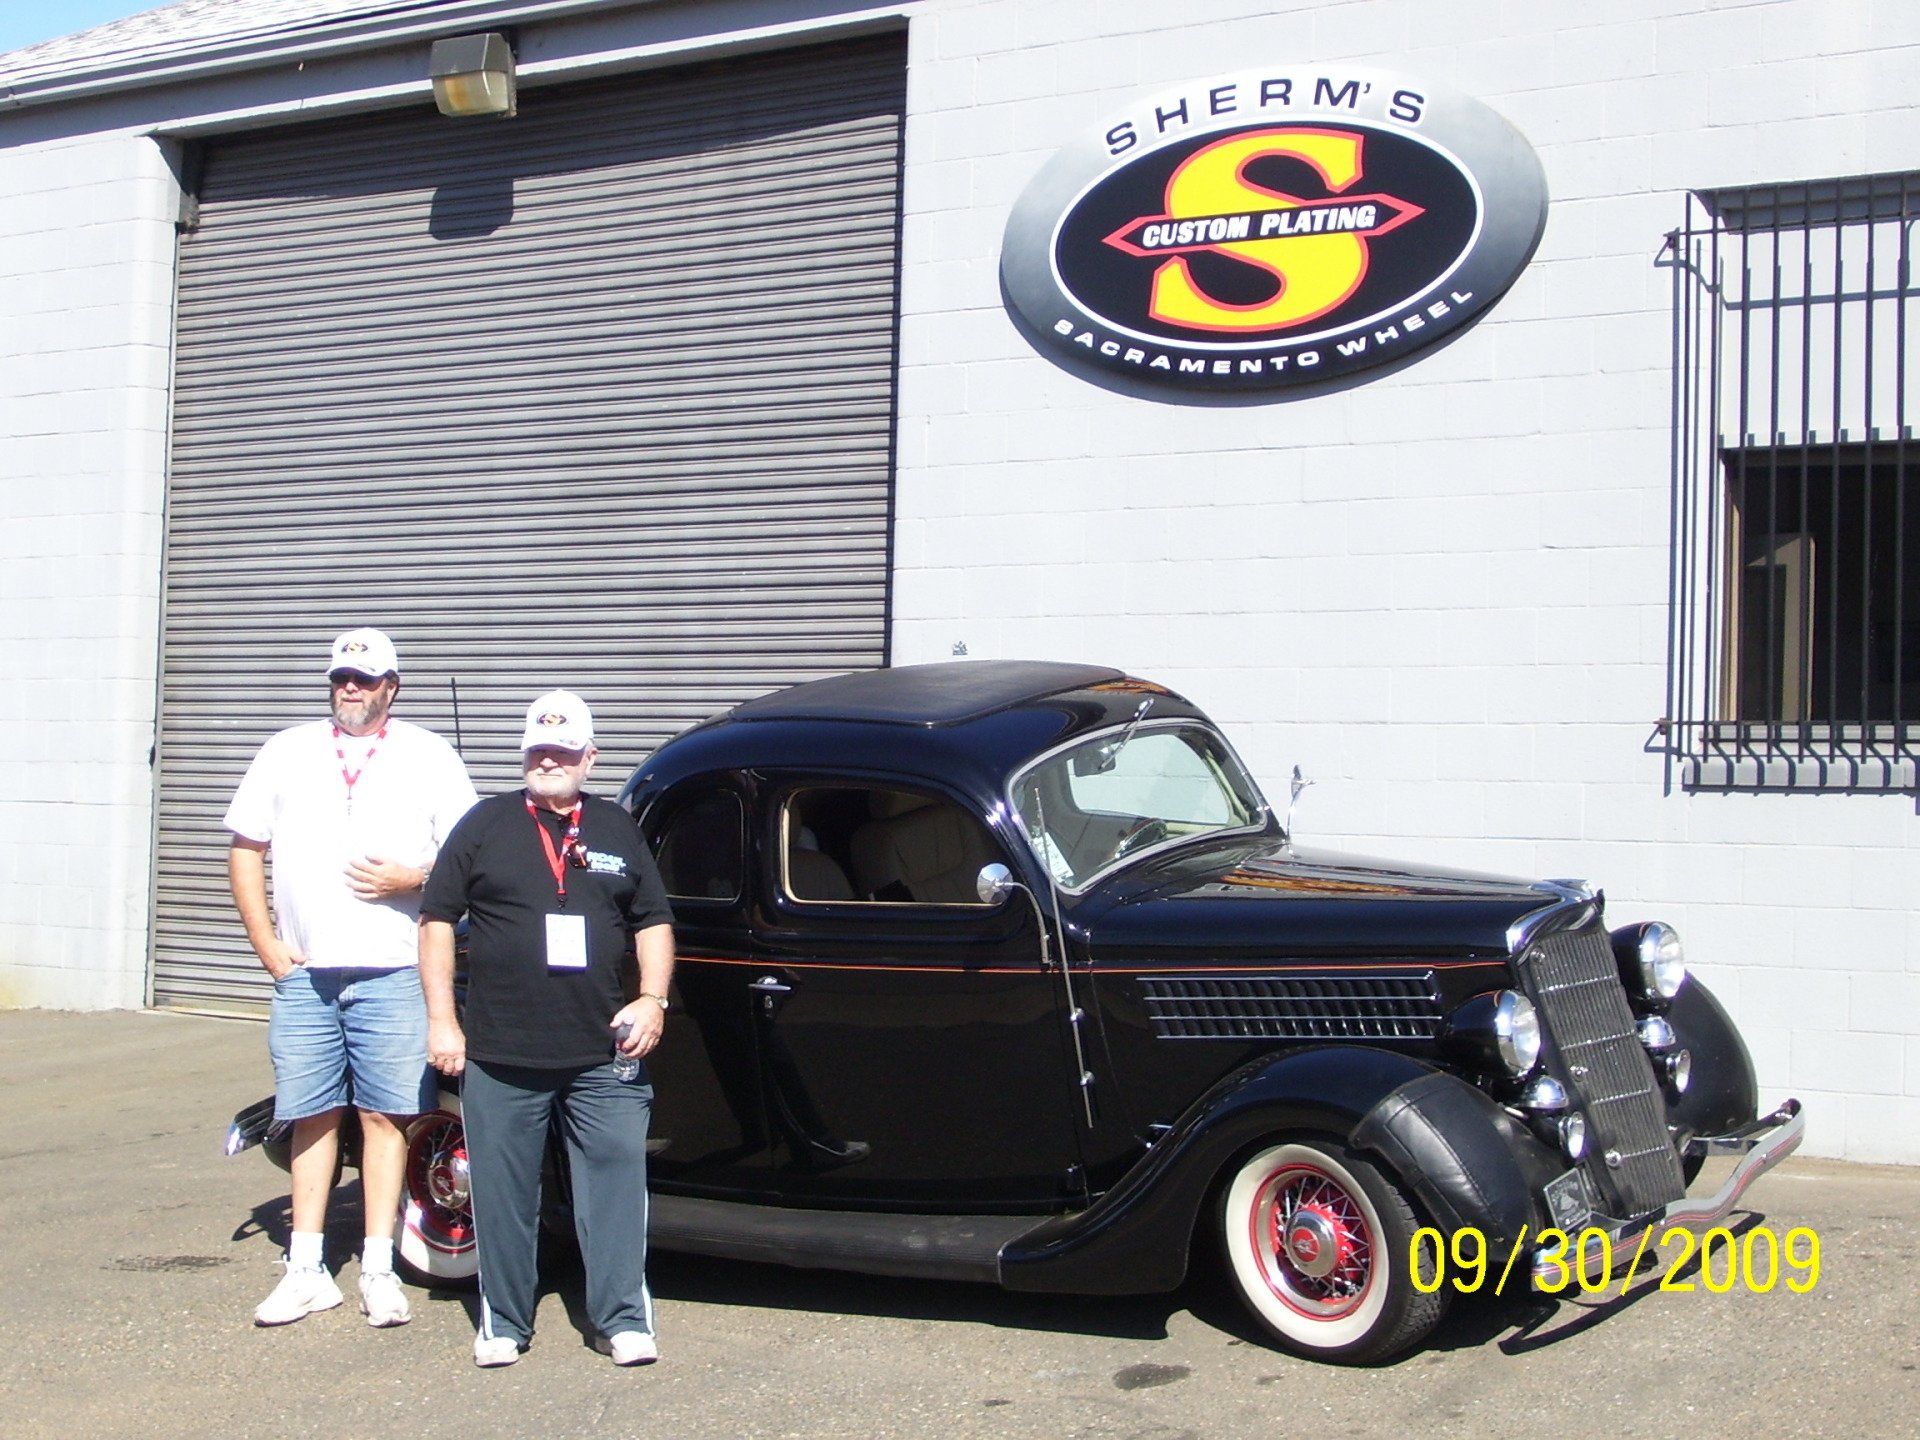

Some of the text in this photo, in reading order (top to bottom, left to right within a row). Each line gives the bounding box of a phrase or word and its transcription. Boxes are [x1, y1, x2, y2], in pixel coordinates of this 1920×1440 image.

[1106, 78, 1424, 155] SHERM'S
[1142, 205, 1376, 247] CUSTOM PLATING
[1054, 290, 1473, 374] SACRAMENTO WHEEL
